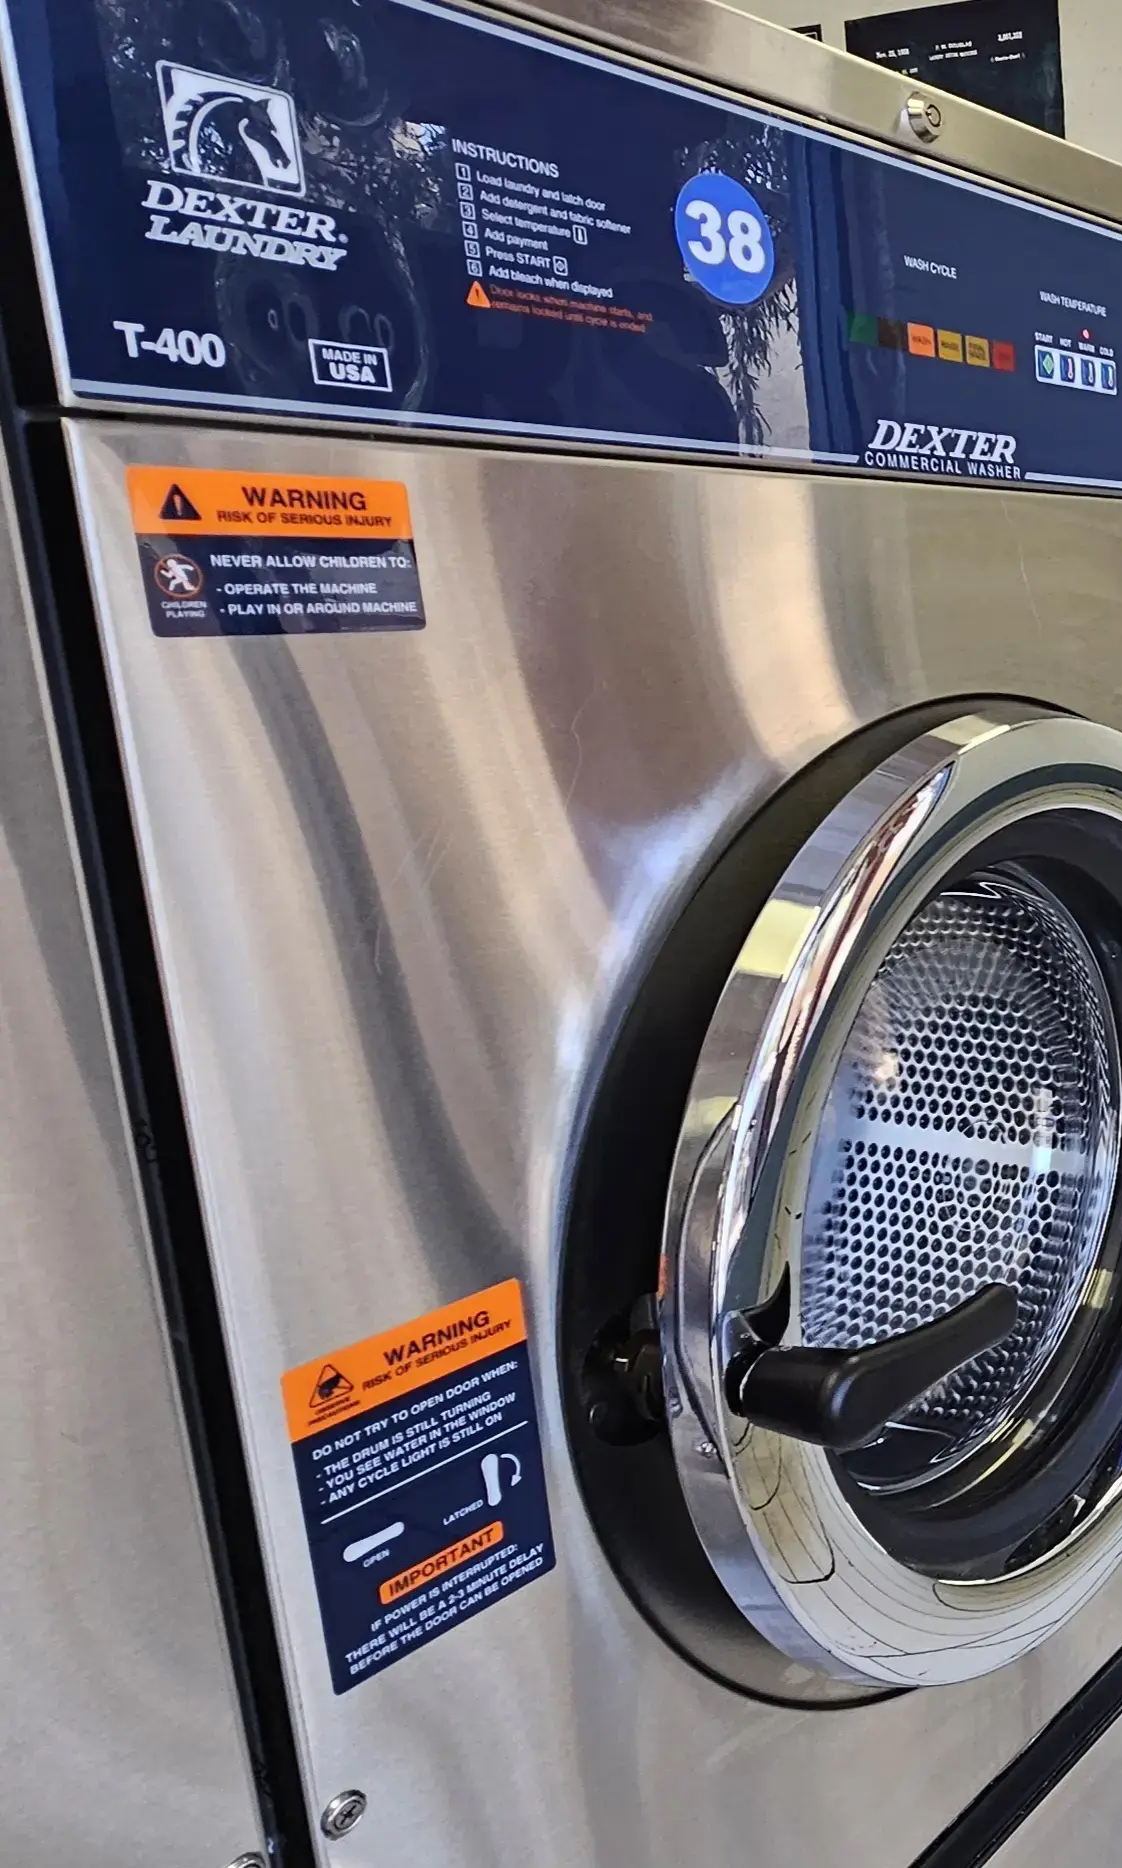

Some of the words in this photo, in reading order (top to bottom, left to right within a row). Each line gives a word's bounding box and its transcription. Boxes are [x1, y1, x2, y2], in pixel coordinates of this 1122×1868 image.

[452, 138, 559, 178] INSTRUCTIONS
[476, 170, 502, 187] Load
[504, 178, 540, 198] laundry
[542, 187, 560, 201] and
[561, 191, 584, 207] latch
[585, 198, 606, 212] door
[141, 180, 337, 242] DEXTER
[480, 190, 500, 205] Add
[502, 196, 548, 216] detergent
[550, 207, 568, 221] and
[569, 210, 595, 227] fabric
[596, 219, 632, 235] softener
[481, 208, 514, 226] Select
[514, 216, 571, 239] temperature
[145, 214, 348, 271] LAUNDRY
[484, 228, 505, 242] Add
[506, 234, 549, 251] payment
[685, 200, 766, 274] 38
[485, 246, 515, 263] Press
[516, 252, 551, 269] START
[904, 255, 930, 272] WASH
[930, 262, 958, 280] CYCLE
[488, 265, 510, 280] Add
[511, 271, 544, 287] bleach
[544, 277, 570, 291] when
[571, 282, 614, 299] displayed
[1040, 290, 1060, 305] WASH
[1061, 296, 1107, 318] TEMPERATURE
[113, 320, 226, 368] T-400
[1034, 331, 1054, 344] START
[1060, 338, 1072, 348] HOT
[1078, 342, 1095, 354] WARM
[1100, 346, 1114, 358] COLD
[322, 347, 361, 364] MADE
[363, 352, 378, 366] IN
[329, 363, 376, 384] USA
[868, 419, 1016, 464] DEXTER
[864, 451, 962, 474] COMMERCIAL
[966, 460, 1021, 480] WASHER
[242, 486, 368, 511] WARNING
[216, 510, 252, 524] RISK
[256, 512, 276, 524] OF
[282, 512, 342, 526] SERIOUS
[346, 514, 392, 528] INJURY
[210, 554, 262, 568] NEVER
[265, 555, 316, 568] ALLOW
[318, 556, 389, 569] CHILDREN
[389, 556, 412, 570] TO:
[224, 583, 290, 596] OPERATE
[292, 583, 318, 595] THE
[320, 582, 378, 594] MACHINE
[161, 600, 208, 610] CHILDREN
[166, 610, 206, 619] PLAYING
[228, 603, 264, 616] PLAY
[266, 603, 280, 615] IN
[283, 603, 304, 615] OR
[306, 602, 360, 614] AROUND
[362, 602, 418, 614] MACHINE
[382, 1310, 491, 1368] WARNING
[362, 1372, 394, 1392] RISK
[395, 1361, 414, 1377] OF
[414, 1338, 468, 1368] SERIOUS
[470, 1318, 513, 1343] INJURY
[312, 1444, 332, 1462] DO
[334, 1432, 363, 1451] NOT
[364, 1419, 389, 1438] TRY
[390, 1410, 409, 1425] TO
[410, 1393, 444, 1416] OPEN
[446, 1377, 480, 1400] DOOR
[482, 1360, 520, 1384] WHEN:
[323, 1458, 350, 1477] THE
[352, 1440, 390, 1464] DRUM
[392, 1432, 404, 1445] IS
[406, 1418, 439, 1440] STILL
[440, 1391, 492, 1423] TURNING
[326, 1468, 355, 1490] YOU
[356, 1456, 382, 1475] SEE
[383, 1434, 428, 1464] WATER
[429, 1427, 442, 1441] IN
[443, 1415, 467, 1433] THE
[468, 1392, 516, 1423] WINDOW
[328, 1484, 356, 1504] ANY
[357, 1462, 400, 1488] CYCLE
[401, 1447, 438, 1468] LIGHT
[438, 1438, 451, 1451] IS
[452, 1424, 484, 1444] STILL
[485, 1412, 503, 1428] ON
[442, 1499, 484, 1526] LATCHED
[362, 1548, 390, 1568] OPEN
[388, 1528, 495, 1598] IMPORTANT
[344, 1634, 387, 1664] THERE
[388, 1618, 418, 1640] WILL
[419, 1608, 436, 1622] BE
[437, 1600, 448, 1612] A
[448, 1590, 466, 1606] 2-3
[466, 1566, 508, 1596] MINUTE
[508, 1542, 545, 1570] DELAY
[371, 1620, 383, 1633] IF
[384, 1595, 427, 1626] POWER
[428, 1587, 440, 1599] IS
[441, 1543, 519, 1593] INTERRUPTED:
[350, 1640, 399, 1676] BEFORE
[400, 1628, 424, 1646] THE
[424, 1607, 458, 1632] DOOR
[458, 1594, 484, 1612] CAN
[484, 1583, 500, 1598] BE
[500, 1556, 544, 1587] OPENED
